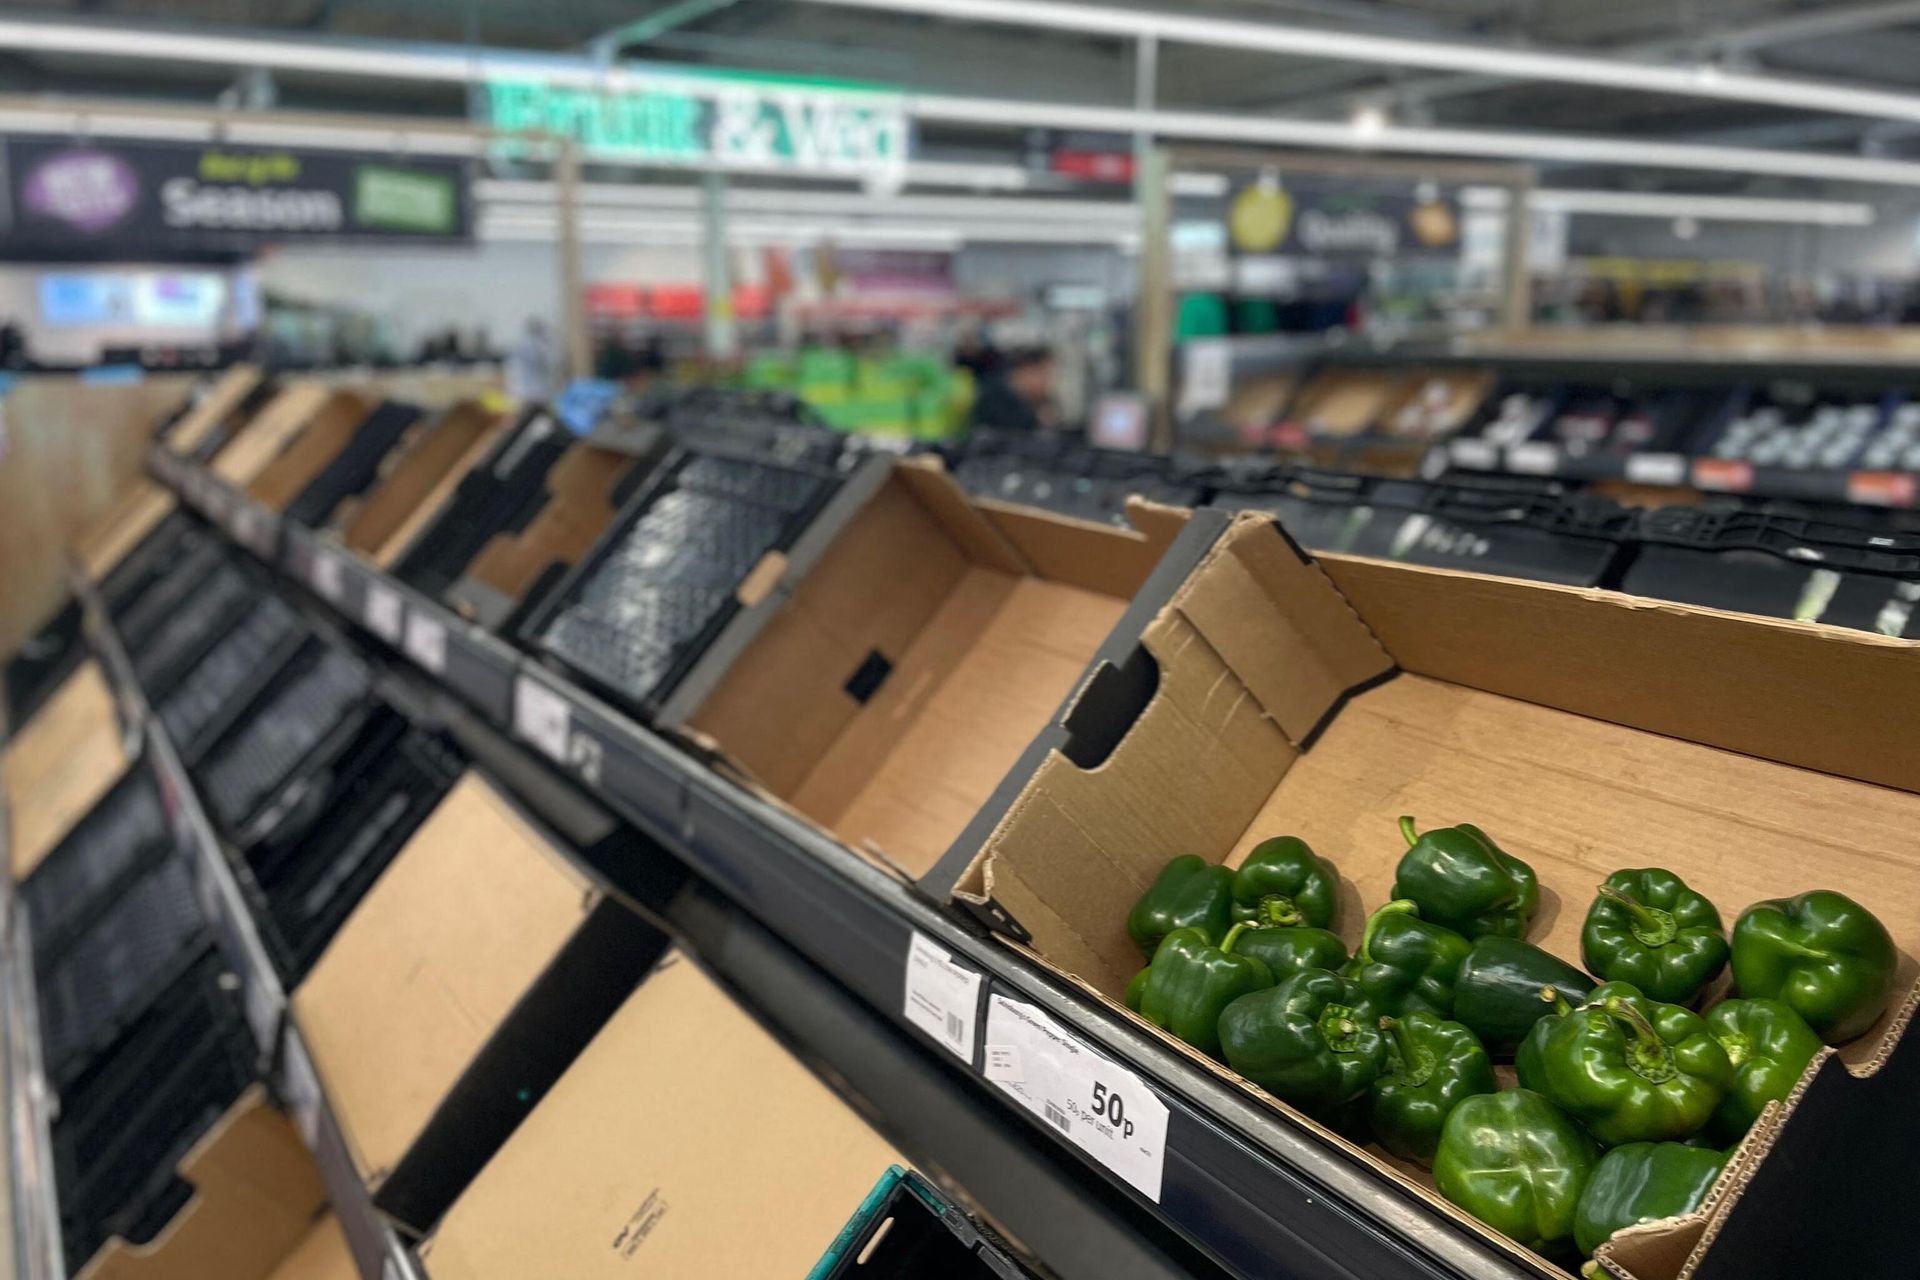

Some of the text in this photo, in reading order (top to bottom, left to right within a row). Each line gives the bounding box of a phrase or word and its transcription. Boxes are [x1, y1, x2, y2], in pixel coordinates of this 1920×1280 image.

[161, 178, 342, 231] Season
[1080, 1110, 1095, 1126] per
[1095, 1120, 1114, 1140] unit
[1091, 1080, 1134, 1140] 50p
